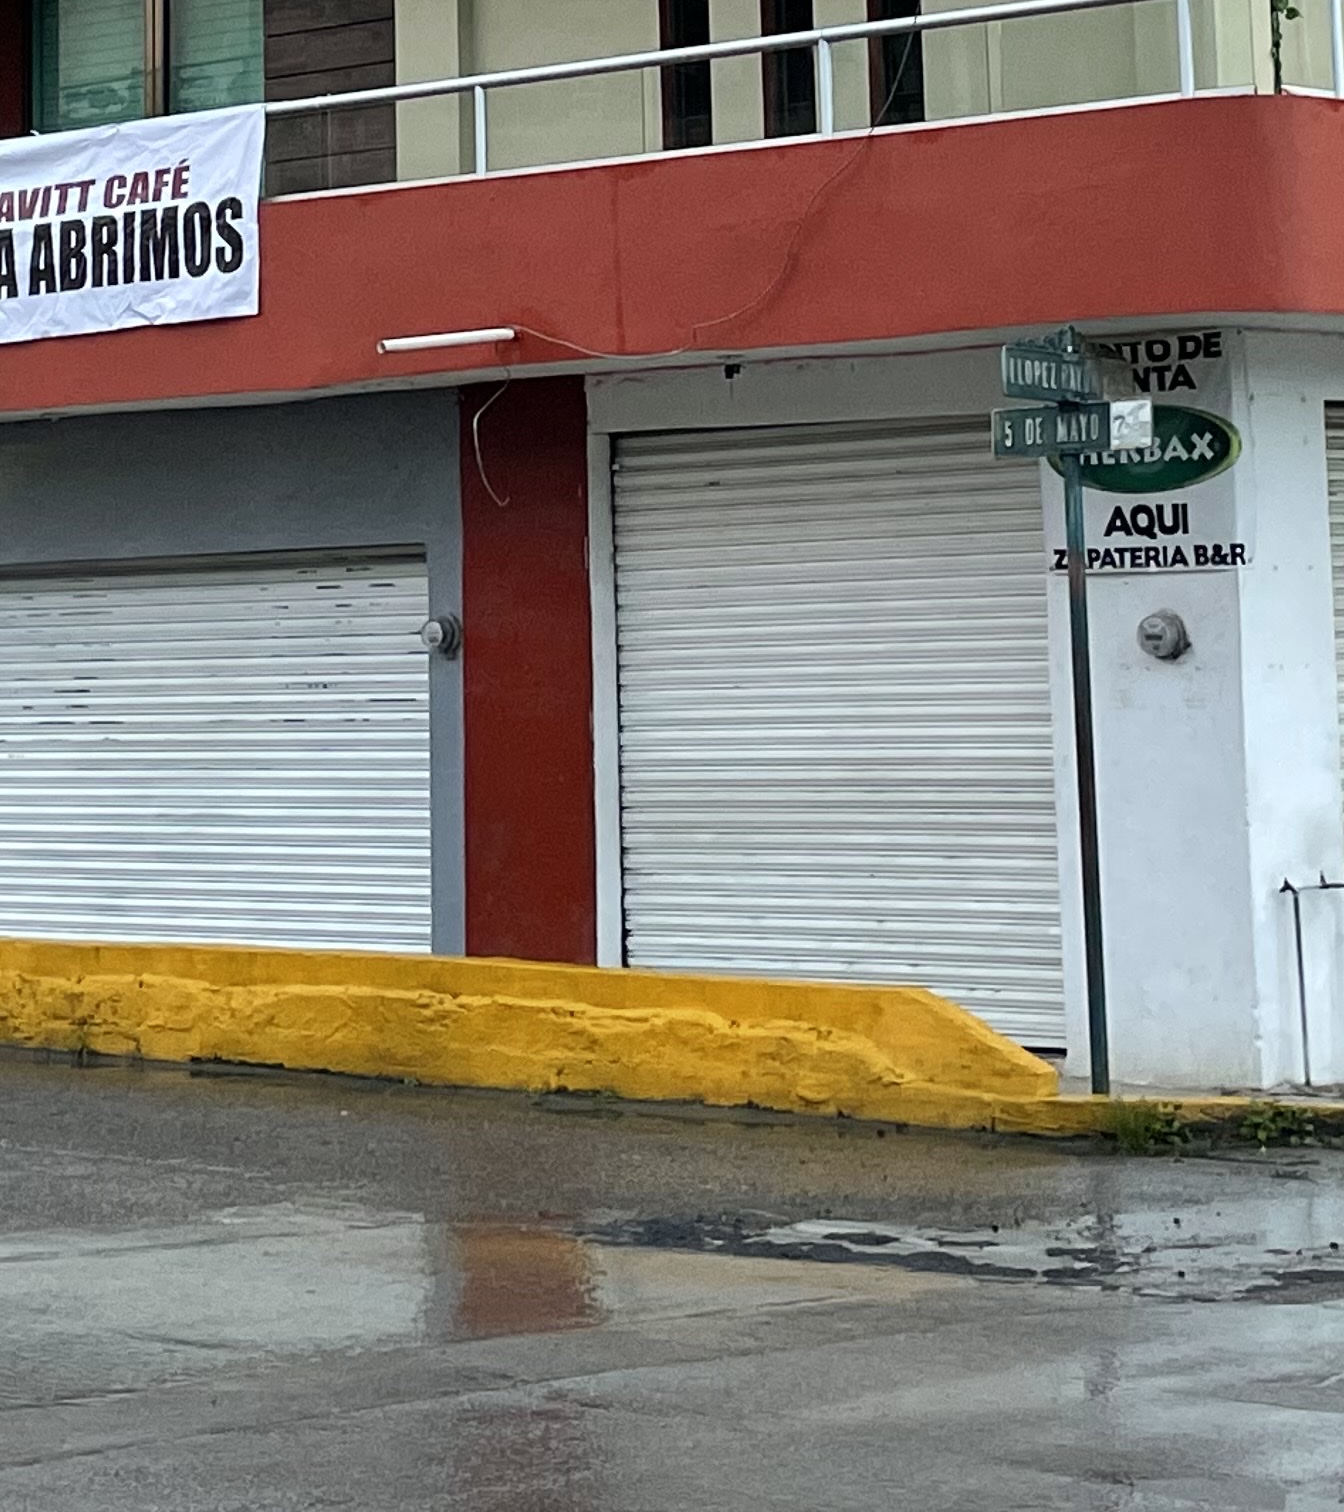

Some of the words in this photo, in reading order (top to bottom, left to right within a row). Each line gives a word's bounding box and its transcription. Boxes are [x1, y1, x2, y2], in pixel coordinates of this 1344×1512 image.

[103, 159, 191, 209] CAFÉ
[29, 197, 243, 296] ABRIMOS
[1178, 331, 1223, 360] DE
[1017, 357, 1057, 390] LOPEZ
[1133, 364, 1197, 393] NTA
[1004, 420, 1013, 447] 5
[1024, 416, 1043, 445] DE
[1056, 413, 1099, 443] MAYO
[1104, 503, 1189, 539] AQUI
[1053, 545, 1189, 570] ZPATERIA
[1194, 543, 1246, 567] B&R
